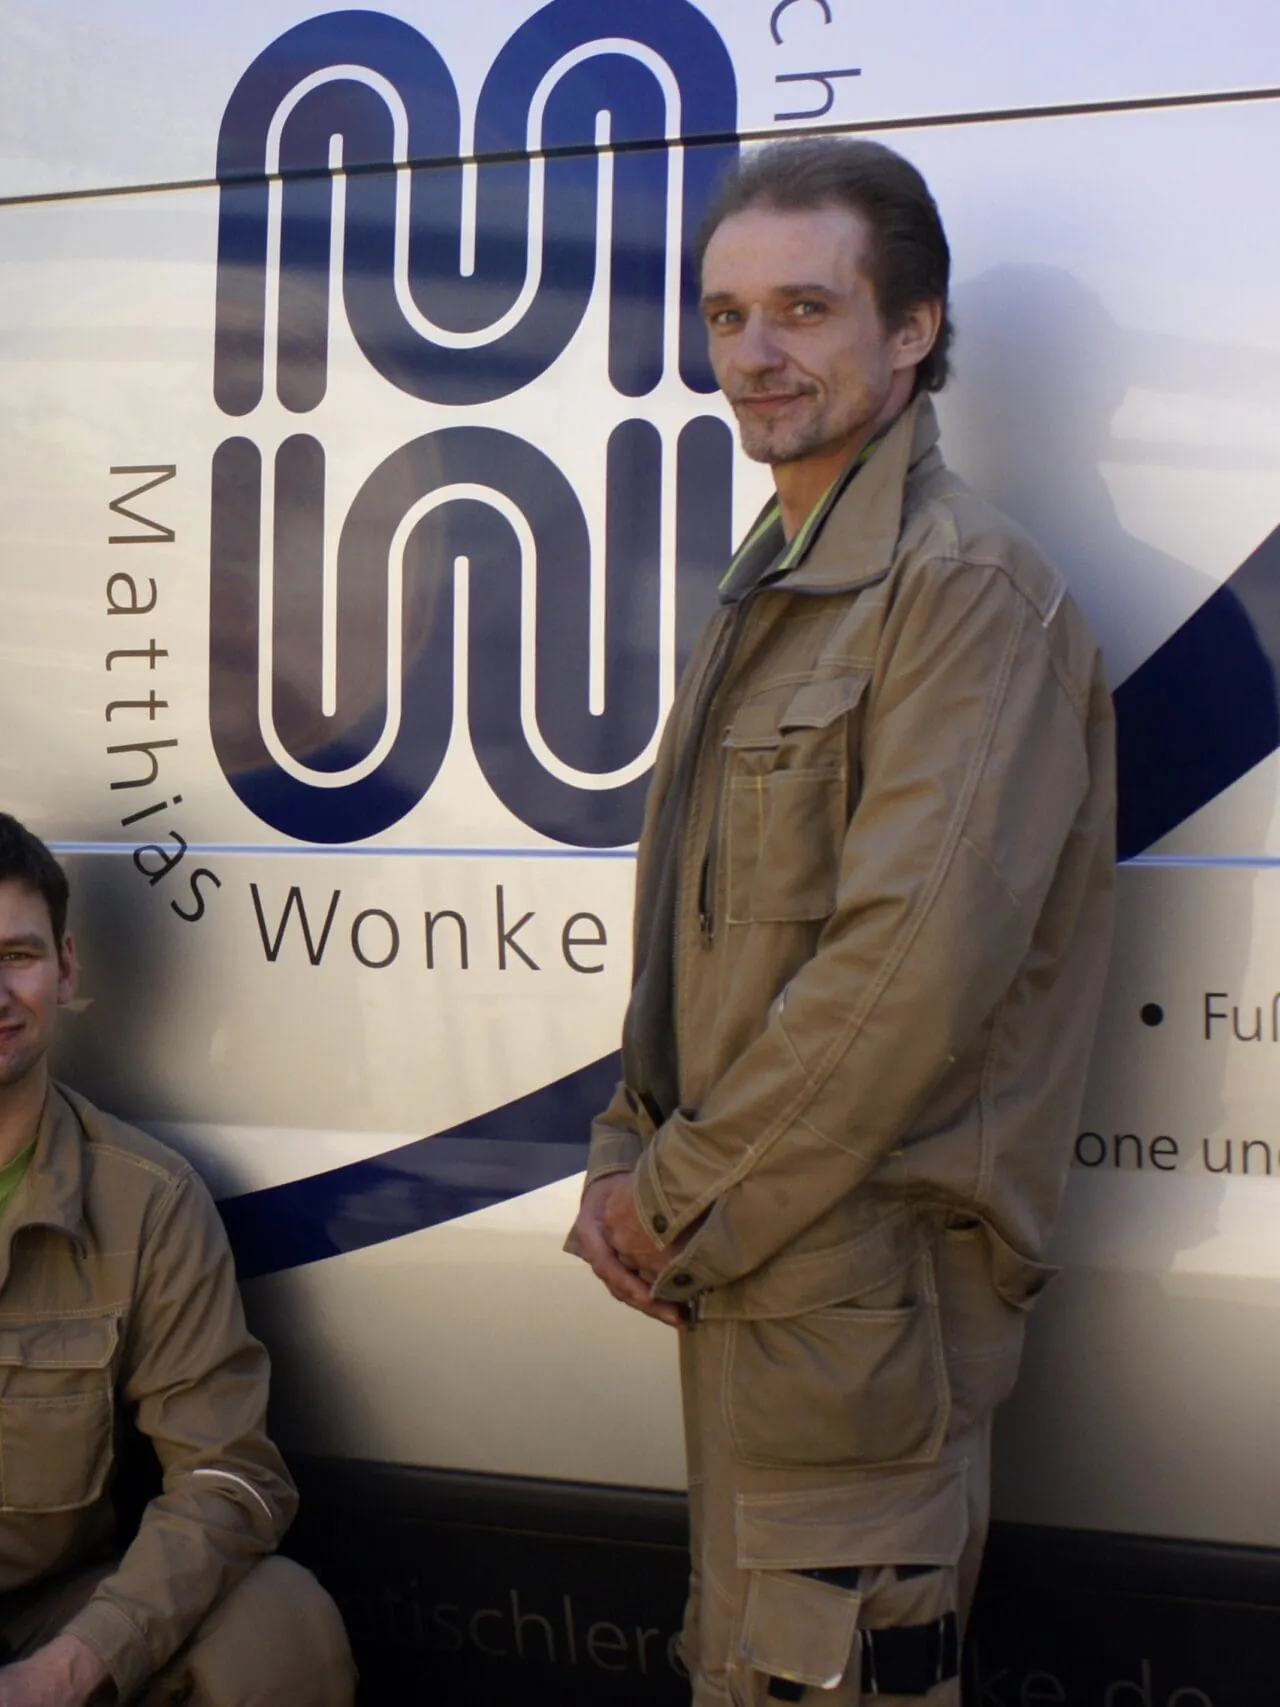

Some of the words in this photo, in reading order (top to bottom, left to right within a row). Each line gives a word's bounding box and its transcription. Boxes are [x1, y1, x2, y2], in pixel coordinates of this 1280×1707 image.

[105, 463, 222, 922] Matthias
[249, 883, 608, 974] Wonke
[1202, 1137, 1280, 1175] un
